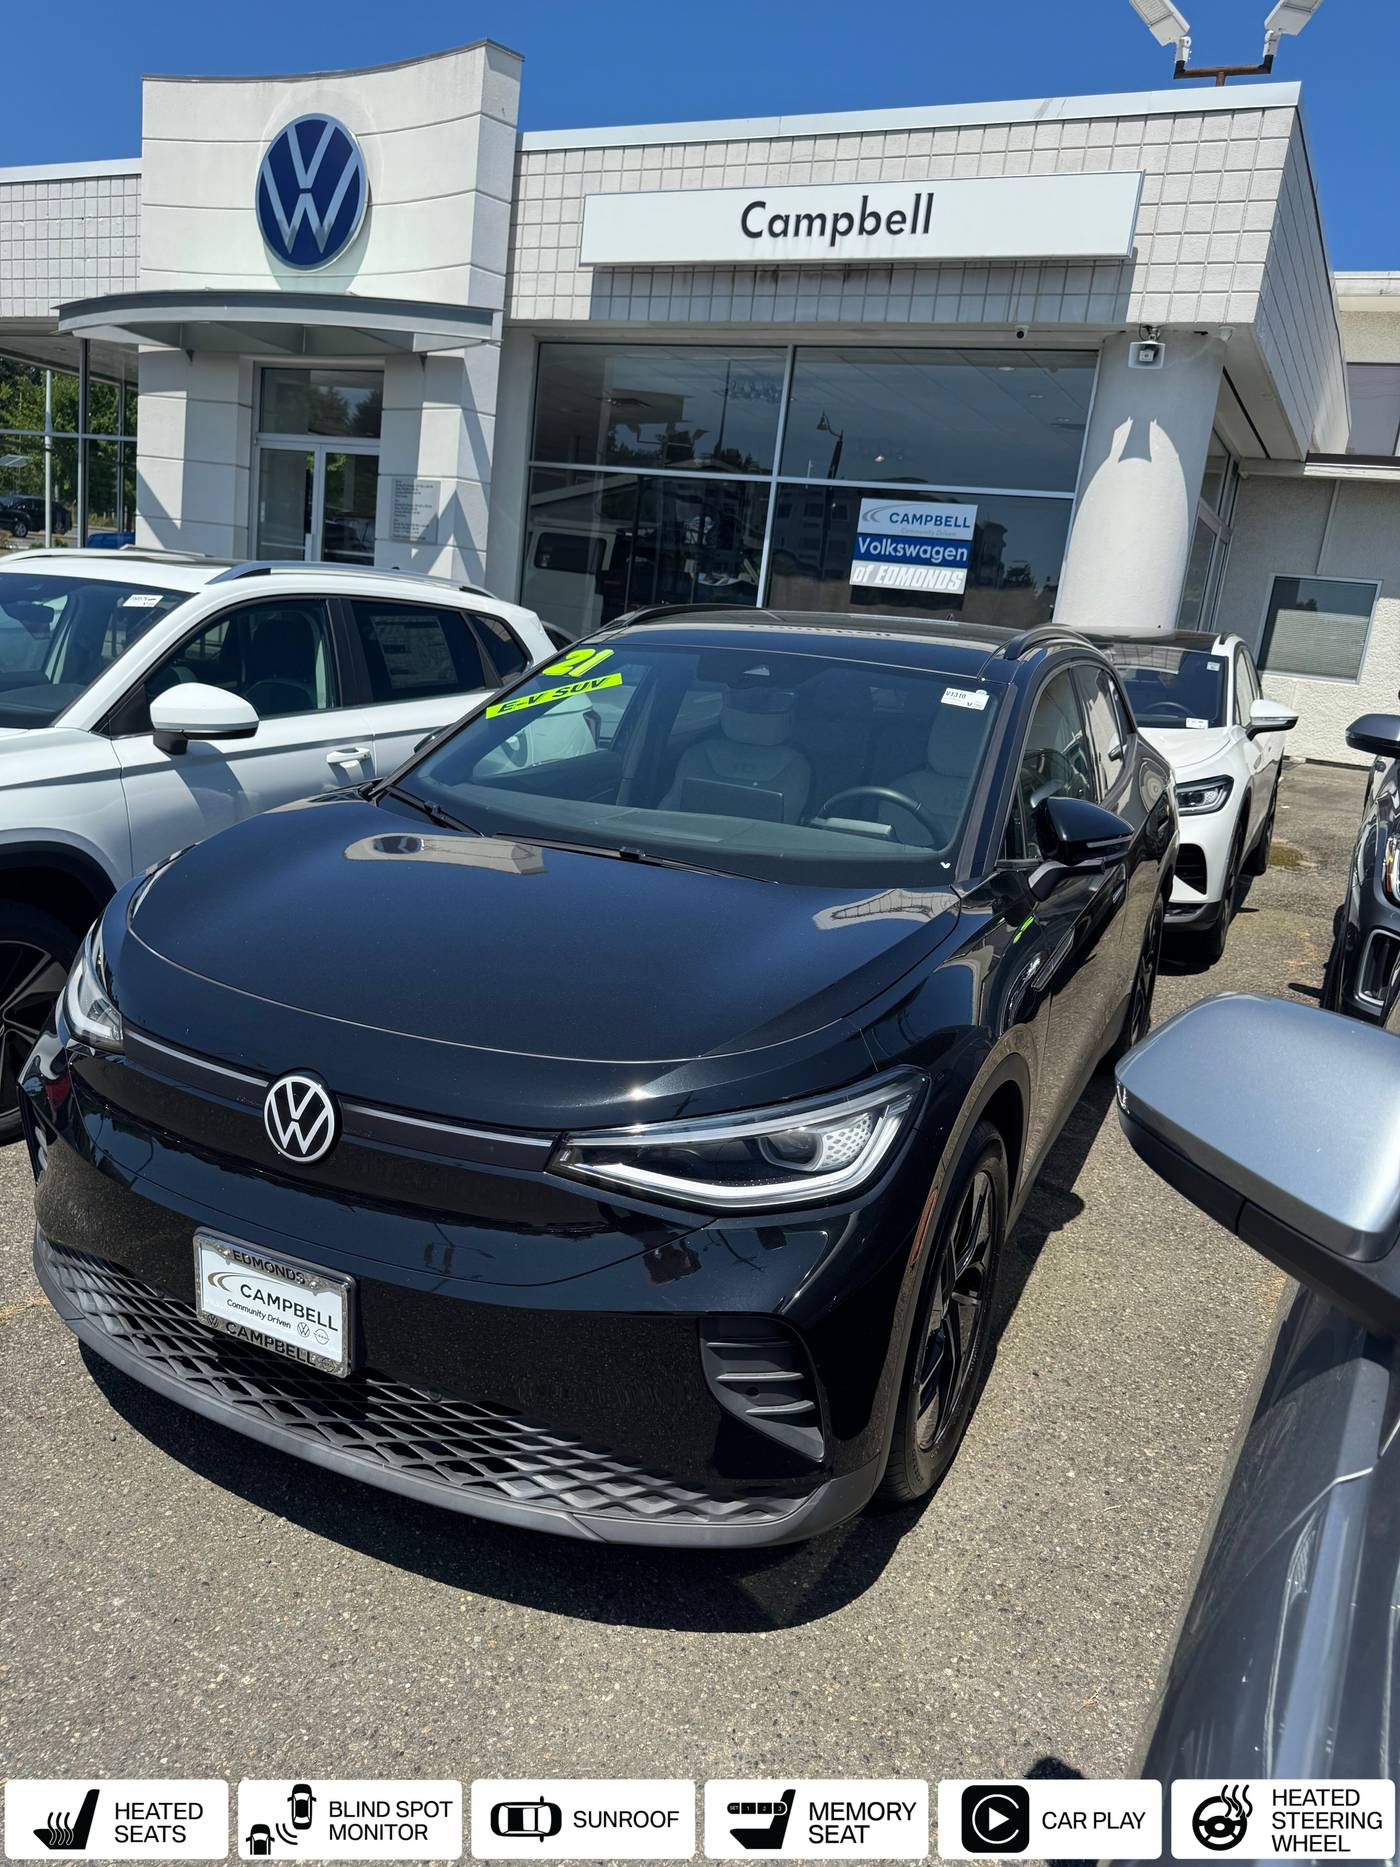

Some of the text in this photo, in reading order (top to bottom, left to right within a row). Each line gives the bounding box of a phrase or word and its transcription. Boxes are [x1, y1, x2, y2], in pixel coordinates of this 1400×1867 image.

[741, 192, 934, 247] Campbell
[889, 512, 971, 529] CAMPBELL
[858, 537, 968, 563] Volkswagen
[853, 564, 964, 590] of EDMONDS
[541, 648, 615, 678] 21
[497, 677, 612, 714] E-V SUV
[232, 1249, 306, 1286] EDMONDS
[226, 1298, 291, 1329] Community Driven
[240, 1284, 338, 1332] CAMPBELL
[226, 1321, 316, 1366] CAMPBELL
